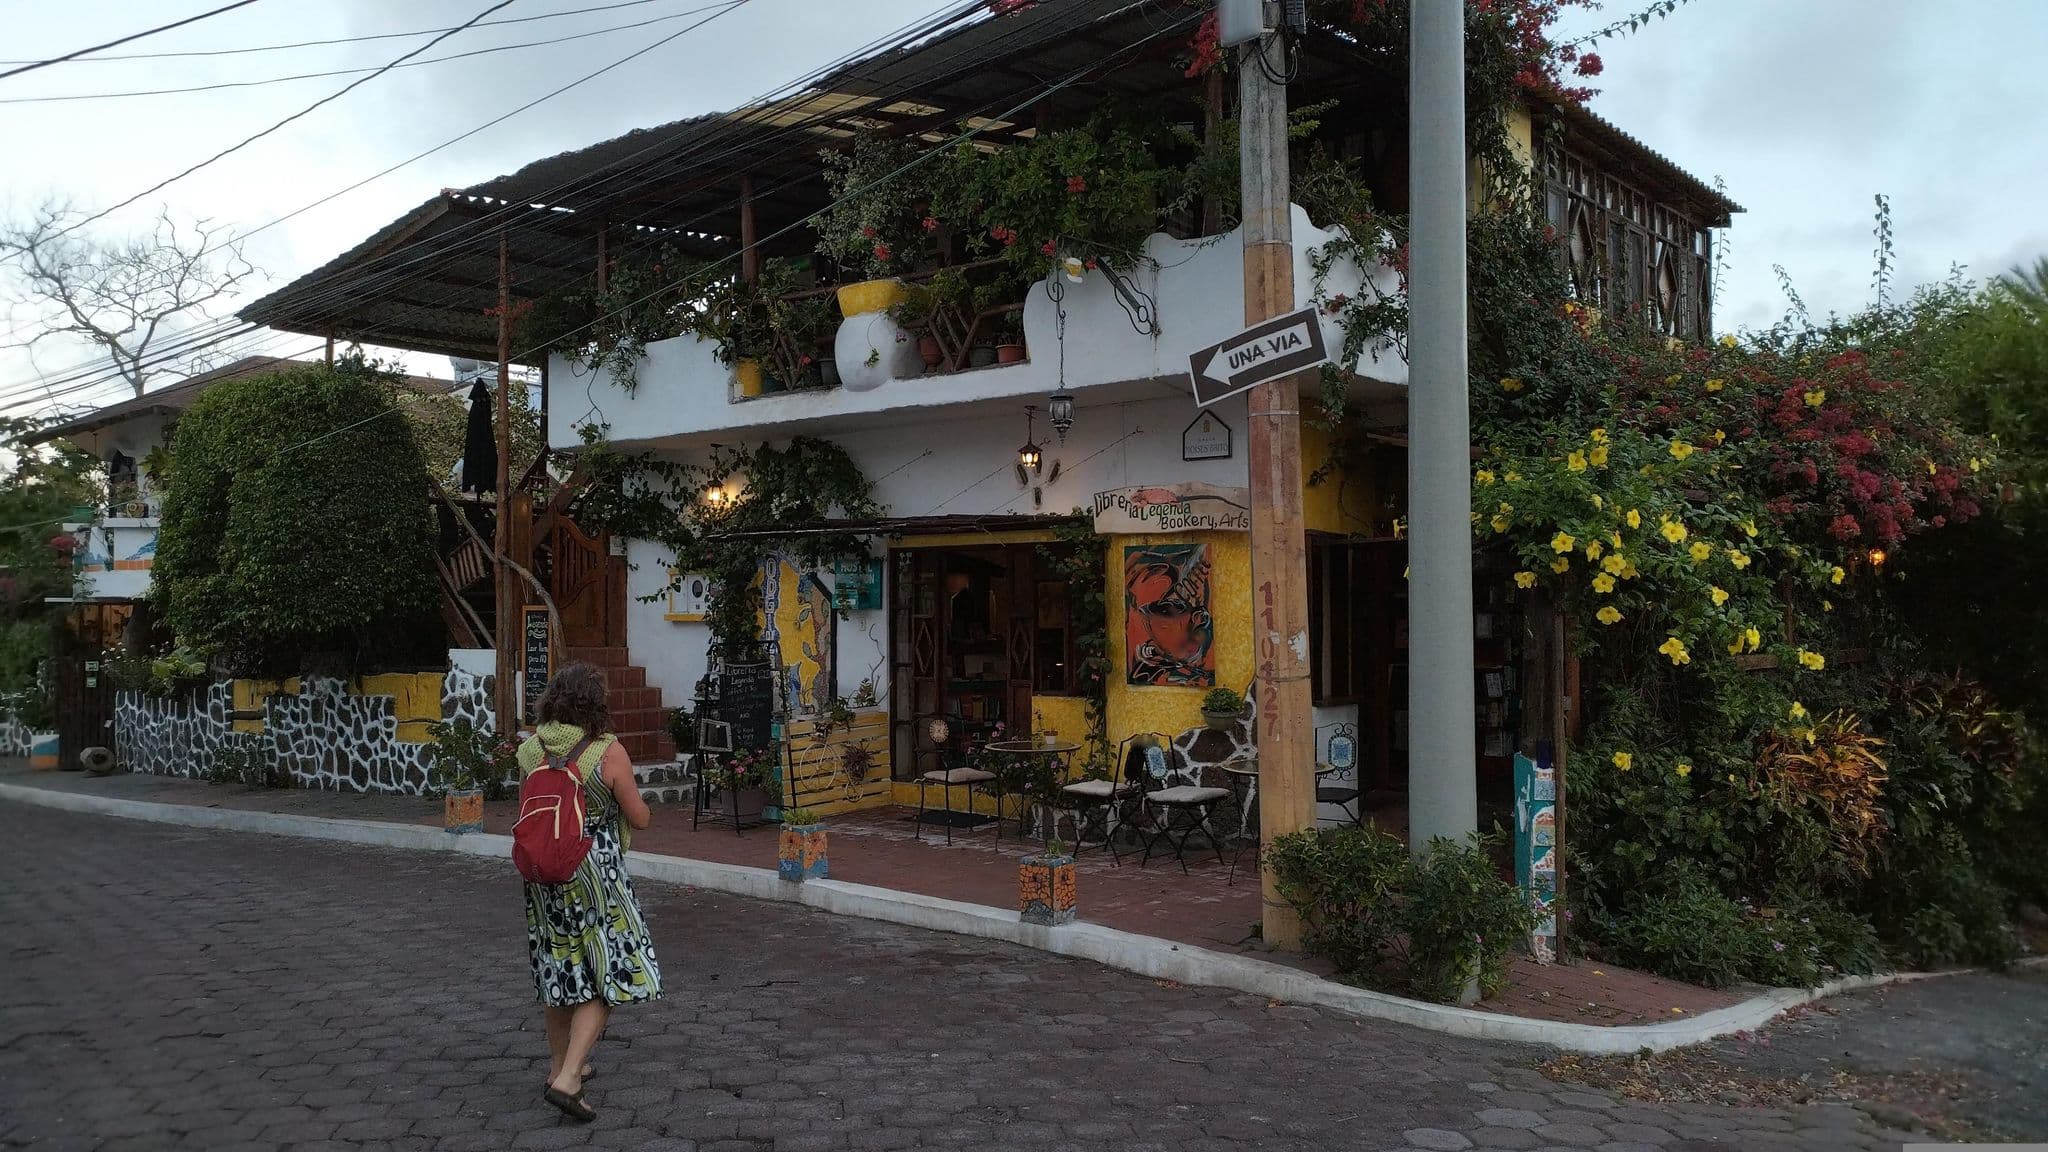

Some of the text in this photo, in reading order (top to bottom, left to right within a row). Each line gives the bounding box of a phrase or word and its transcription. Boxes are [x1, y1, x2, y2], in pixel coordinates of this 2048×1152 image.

[1228, 332, 1302, 369] UNA VIA
[1140, 503, 1192, 525] Legenda
[1161, 511, 1249, 530] Bookery, Arts
[1259, 580, 1279, 737] 110427
